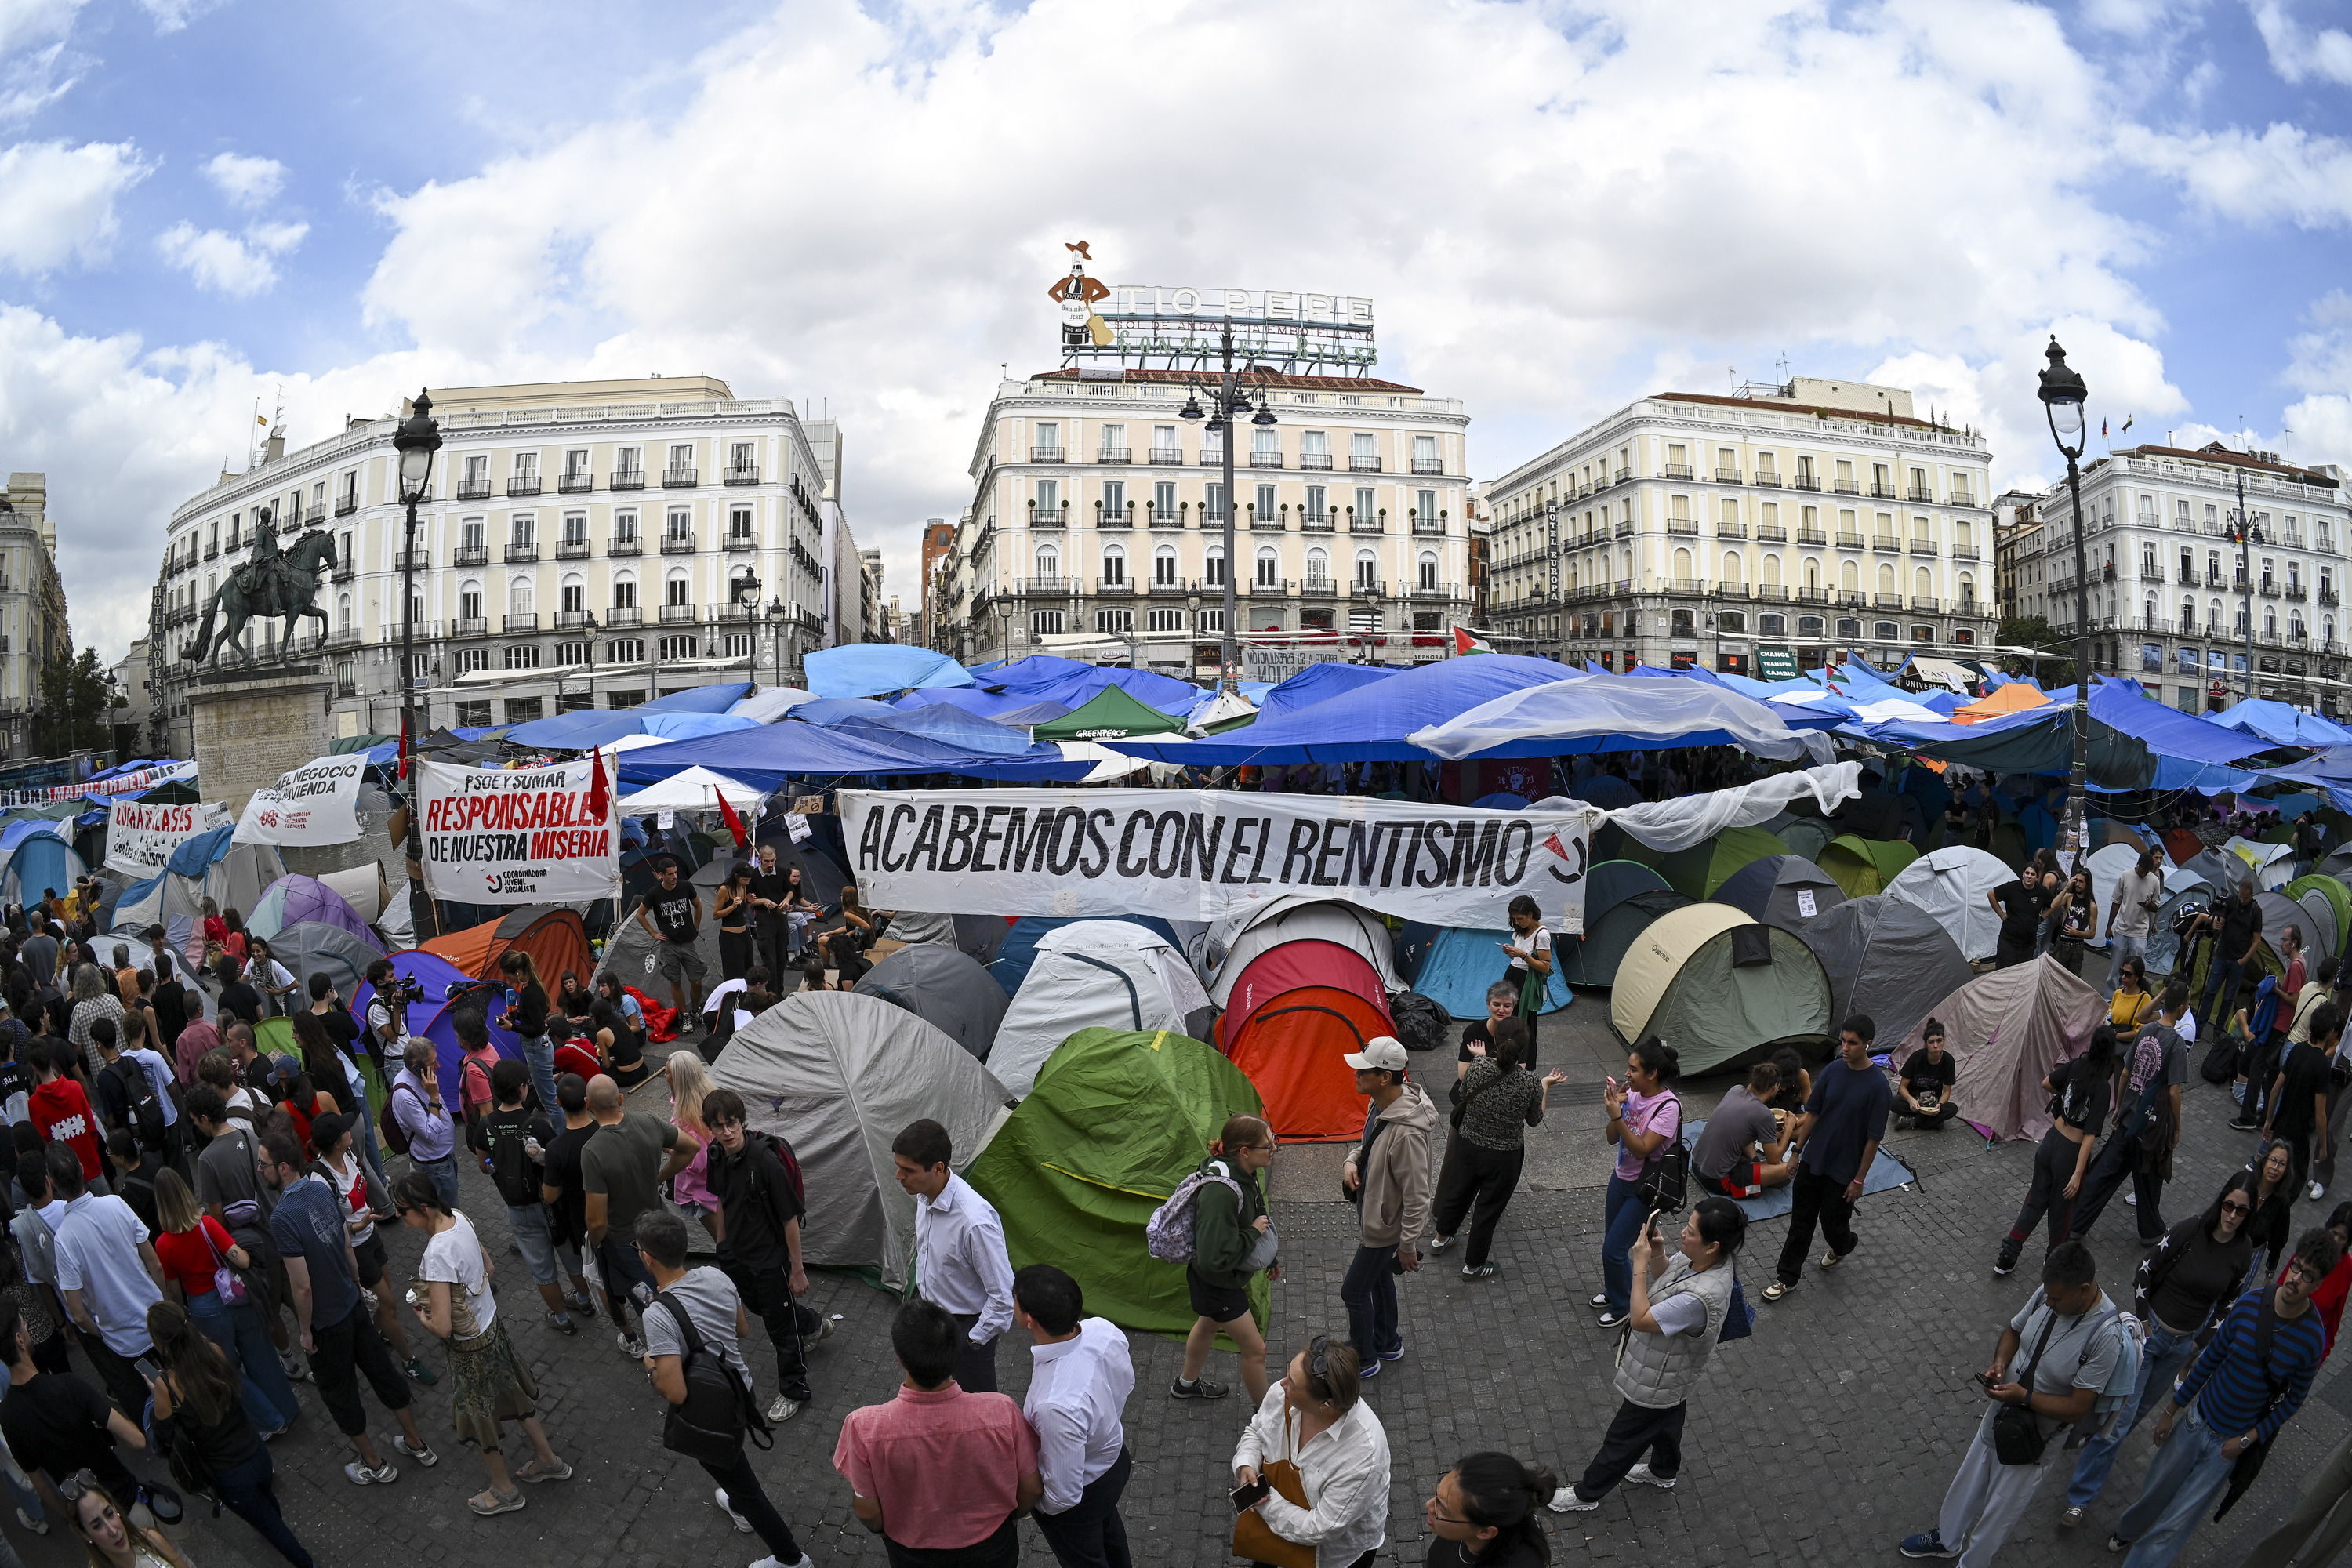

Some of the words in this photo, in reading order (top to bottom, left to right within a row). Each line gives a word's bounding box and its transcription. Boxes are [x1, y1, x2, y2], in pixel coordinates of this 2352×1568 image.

[1118, 285, 1202, 315] TIO
[1224, 288, 1374, 326] PEPE
[1115, 321, 1146, 329] SOL
[1267, 325, 1374, 340] EMBOTELLADO
[1119, 330, 1267, 358] GONZAEZ
[1296, 336, 1378, 365] BYASS
[1548, 506, 1557, 545] HOTEL
[153, 588, 162, 634] HOTEL
[153, 641, 162, 706] MODERNO
[1922, 669, 1944, 679] CAS
[1905, 680, 1955, 693] UNIVERSIDAD
[1076, 729, 1129, 739] GREENPEACE
[281, 773, 292, 789] EL
[292, 764, 358, 784] NEGOCIO
[1504, 766, 1529, 776] VIVE
[1526, 775, 1534, 784] 71
[465, 775, 500, 793] PSOE
[503, 775, 512, 788] Y
[513, 771, 566, 789] SUMAR
[0, 789, 16, 808] NI
[19, 789, 50, 805] UNA
[430, 837, 449, 862] DE
[450, 833, 527, 862] NUESTRA
[531, 829, 609, 860] MISERIA
[859, 804, 1114, 879] ACABEMOS
[1116, 808, 1225, 884] CON
[1220, 818, 1272, 884] EL
[1279, 819, 1533, 889] RENTISMO
[503, 869, 547, 879] COORDINADORA
[341, 889, 365, 898] uechua
[504, 884, 536, 893] SOCIALISTA
[661, 907, 670, 916] DE
[670, 902, 688, 915] CLASE
[1651, 944, 1670, 962] Quechua
